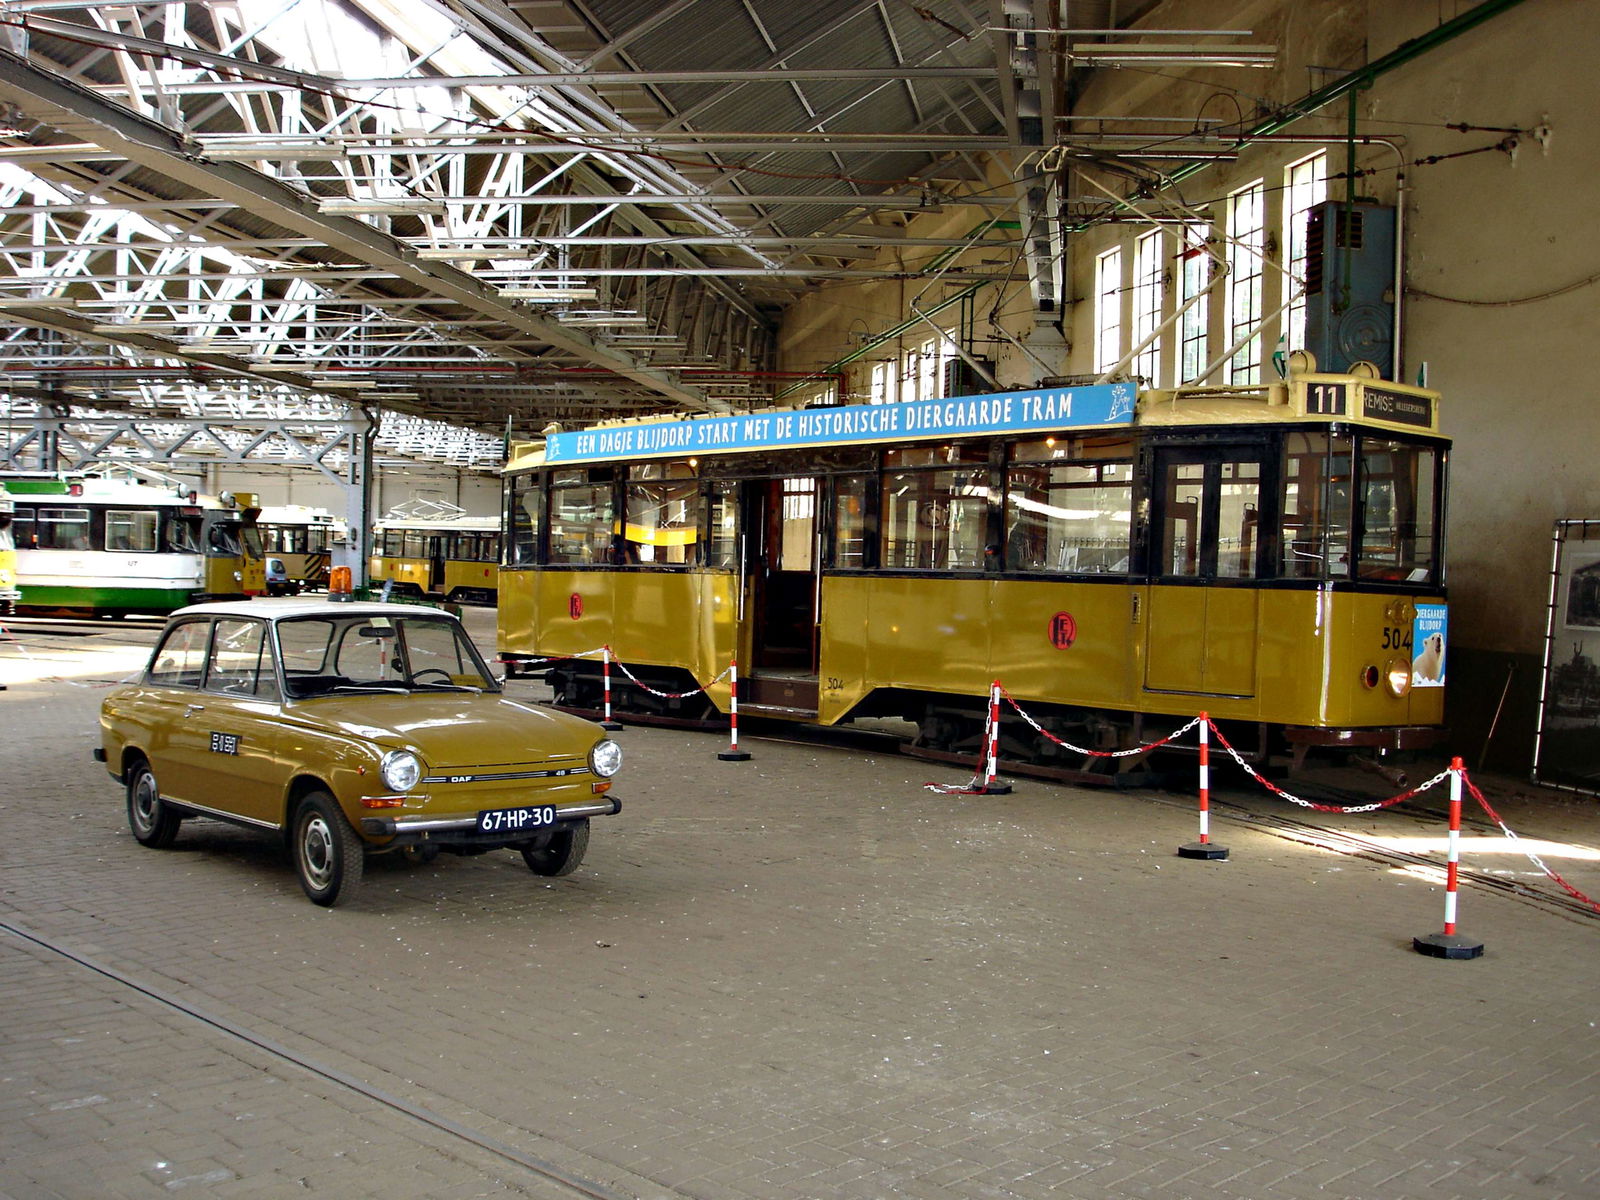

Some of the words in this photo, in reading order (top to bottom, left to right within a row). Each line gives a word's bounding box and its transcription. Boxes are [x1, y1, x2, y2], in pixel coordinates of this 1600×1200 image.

[1314, 386, 1337, 413] 11
[1364, 391, 1394, 413] REMISE
[576, 435, 595, 454] EEN
[599, 433, 632, 454] DAGJE
[637, 425, 692, 450] BLIJDORP
[697, 422, 738, 445] START
[744, 419, 770, 441] MET
[776, 416, 792, 438] DE
[799, 407, 898, 437] HISTORISCHE
[906, 399, 1013, 430] DIERGAARDE
[1022, 392, 1073, 422] TRAM
[1419, 619, 1442, 631] BLIJDORP
[1381, 627, 1412, 650] 504
[827, 677, 845, 691] 504
[481, 807, 554, 830] 67-HP-30
